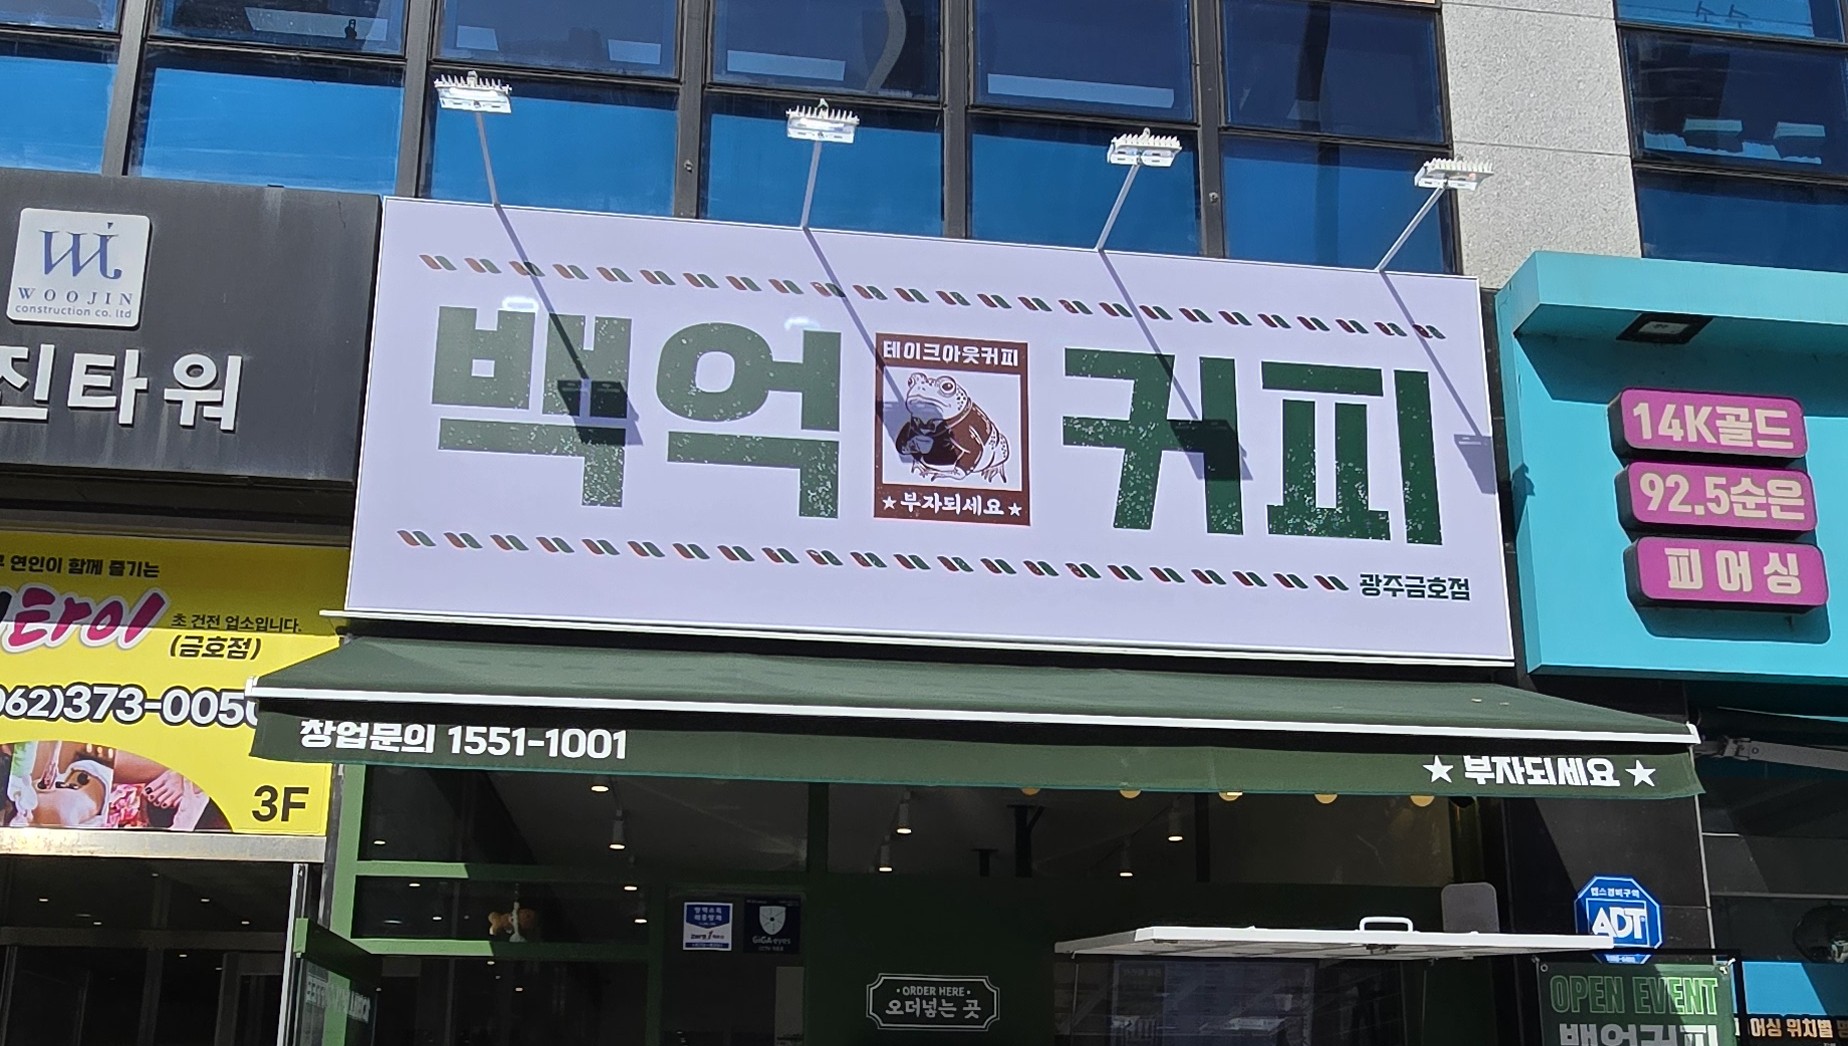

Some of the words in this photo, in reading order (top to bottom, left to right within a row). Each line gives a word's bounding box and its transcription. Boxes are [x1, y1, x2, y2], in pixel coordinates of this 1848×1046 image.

[18, 286, 133, 306] WOOJIN
[15, 304, 91, 318] construction
[115, 309, 132, 319] ltd
[883, 341, 1019, 367] 테이크아웃커피
[431, 305, 842, 520] 백억
[1062, 347, 1443, 546] 커피
[1633, 402, 1795, 450] 14K골드
[900, 493, 1005, 516] 부자되세요
[1639, 472, 1805, 521] 92.5순은
[10, 555, 63, 574] 연인이
[68, 557, 104, 576] 함께
[109, 559, 161, 578] 즐기는
[1359, 573, 1471, 602] 광주금호점
[171, 613, 187, 627] 초
[191, 614, 220, 630] 건전
[170, 634, 262, 661] (금호점)
[0, 684, 258, 727] 62)373-005
[300, 719, 436, 753] 창업문의
[448, 725, 627, 760] 1551-1001
[251, 786, 310, 823] 3F
[1592, 906, 1647, 940] ADT
[902, 986, 936, 996] ORDER
[938, 987, 965, 997] HERE
[1550, 975, 1625, 1013] OPEN
[1632, 976, 1718, 1015] EVENT
[962, 999, 982, 1019] 곳
